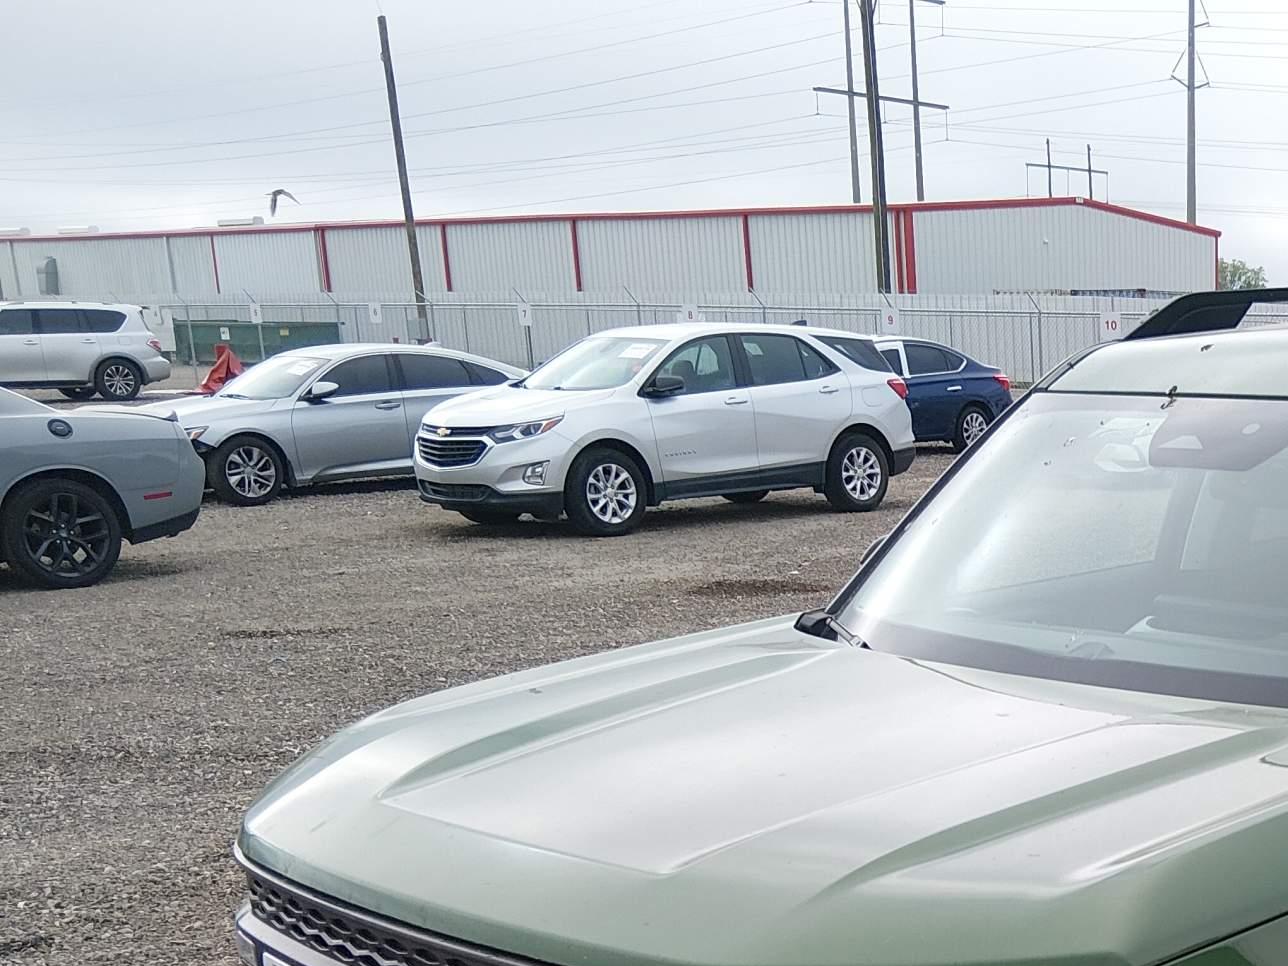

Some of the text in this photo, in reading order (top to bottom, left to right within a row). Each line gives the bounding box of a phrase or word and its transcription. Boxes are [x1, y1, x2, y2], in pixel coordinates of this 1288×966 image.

[522, 310, 527, 318] 7
[688, 310, 693, 320] 8
[887, 315, 894, 325] 9
[1105, 320, 1117, 331] 10
